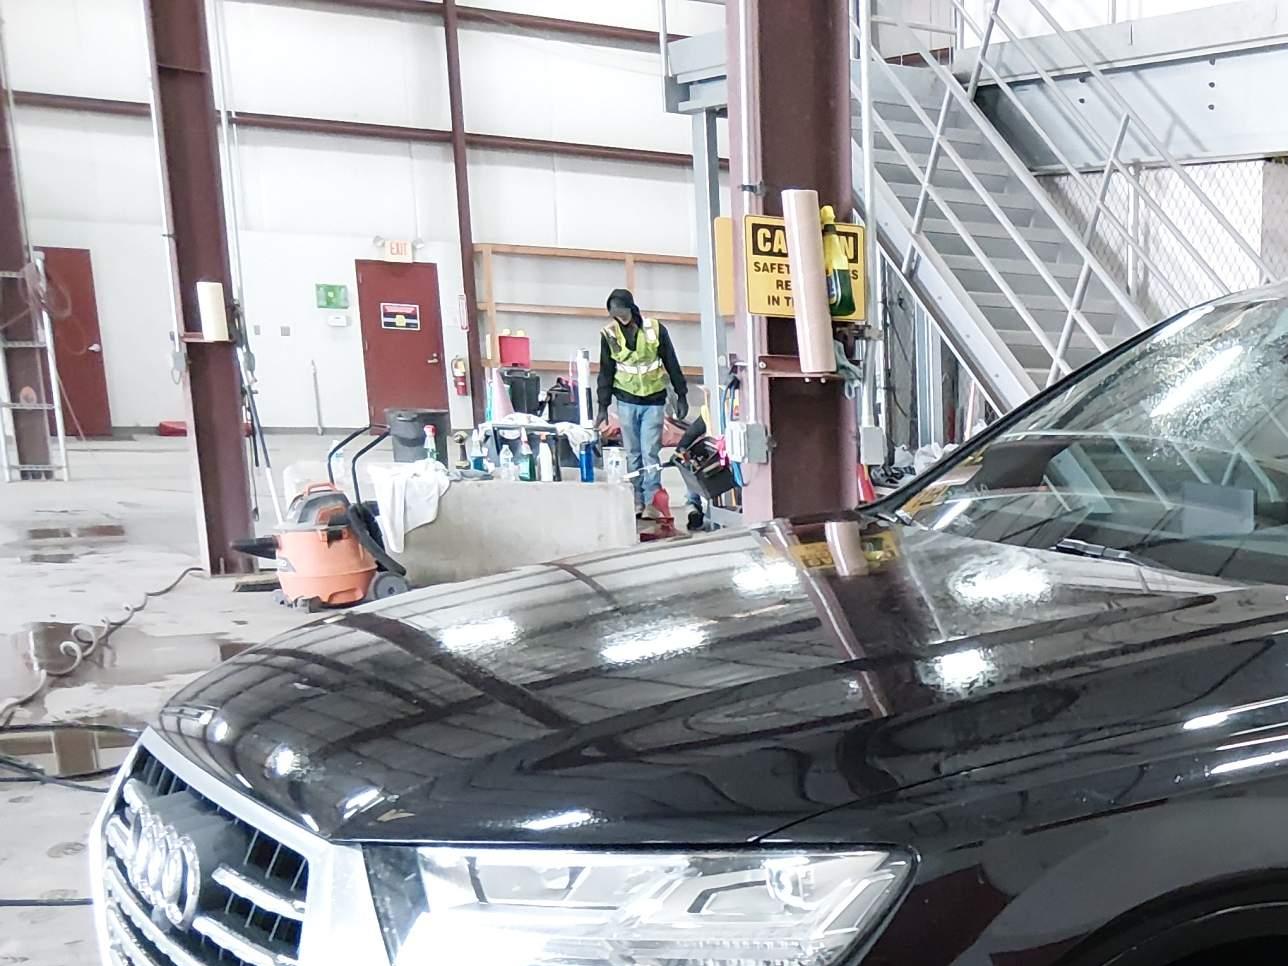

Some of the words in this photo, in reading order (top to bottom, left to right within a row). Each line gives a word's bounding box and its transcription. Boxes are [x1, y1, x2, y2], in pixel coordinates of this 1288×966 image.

[390, 241, 407, 256] EXIT
[753, 261, 791, 274] SAFET
[767, 295, 780, 306] IN
